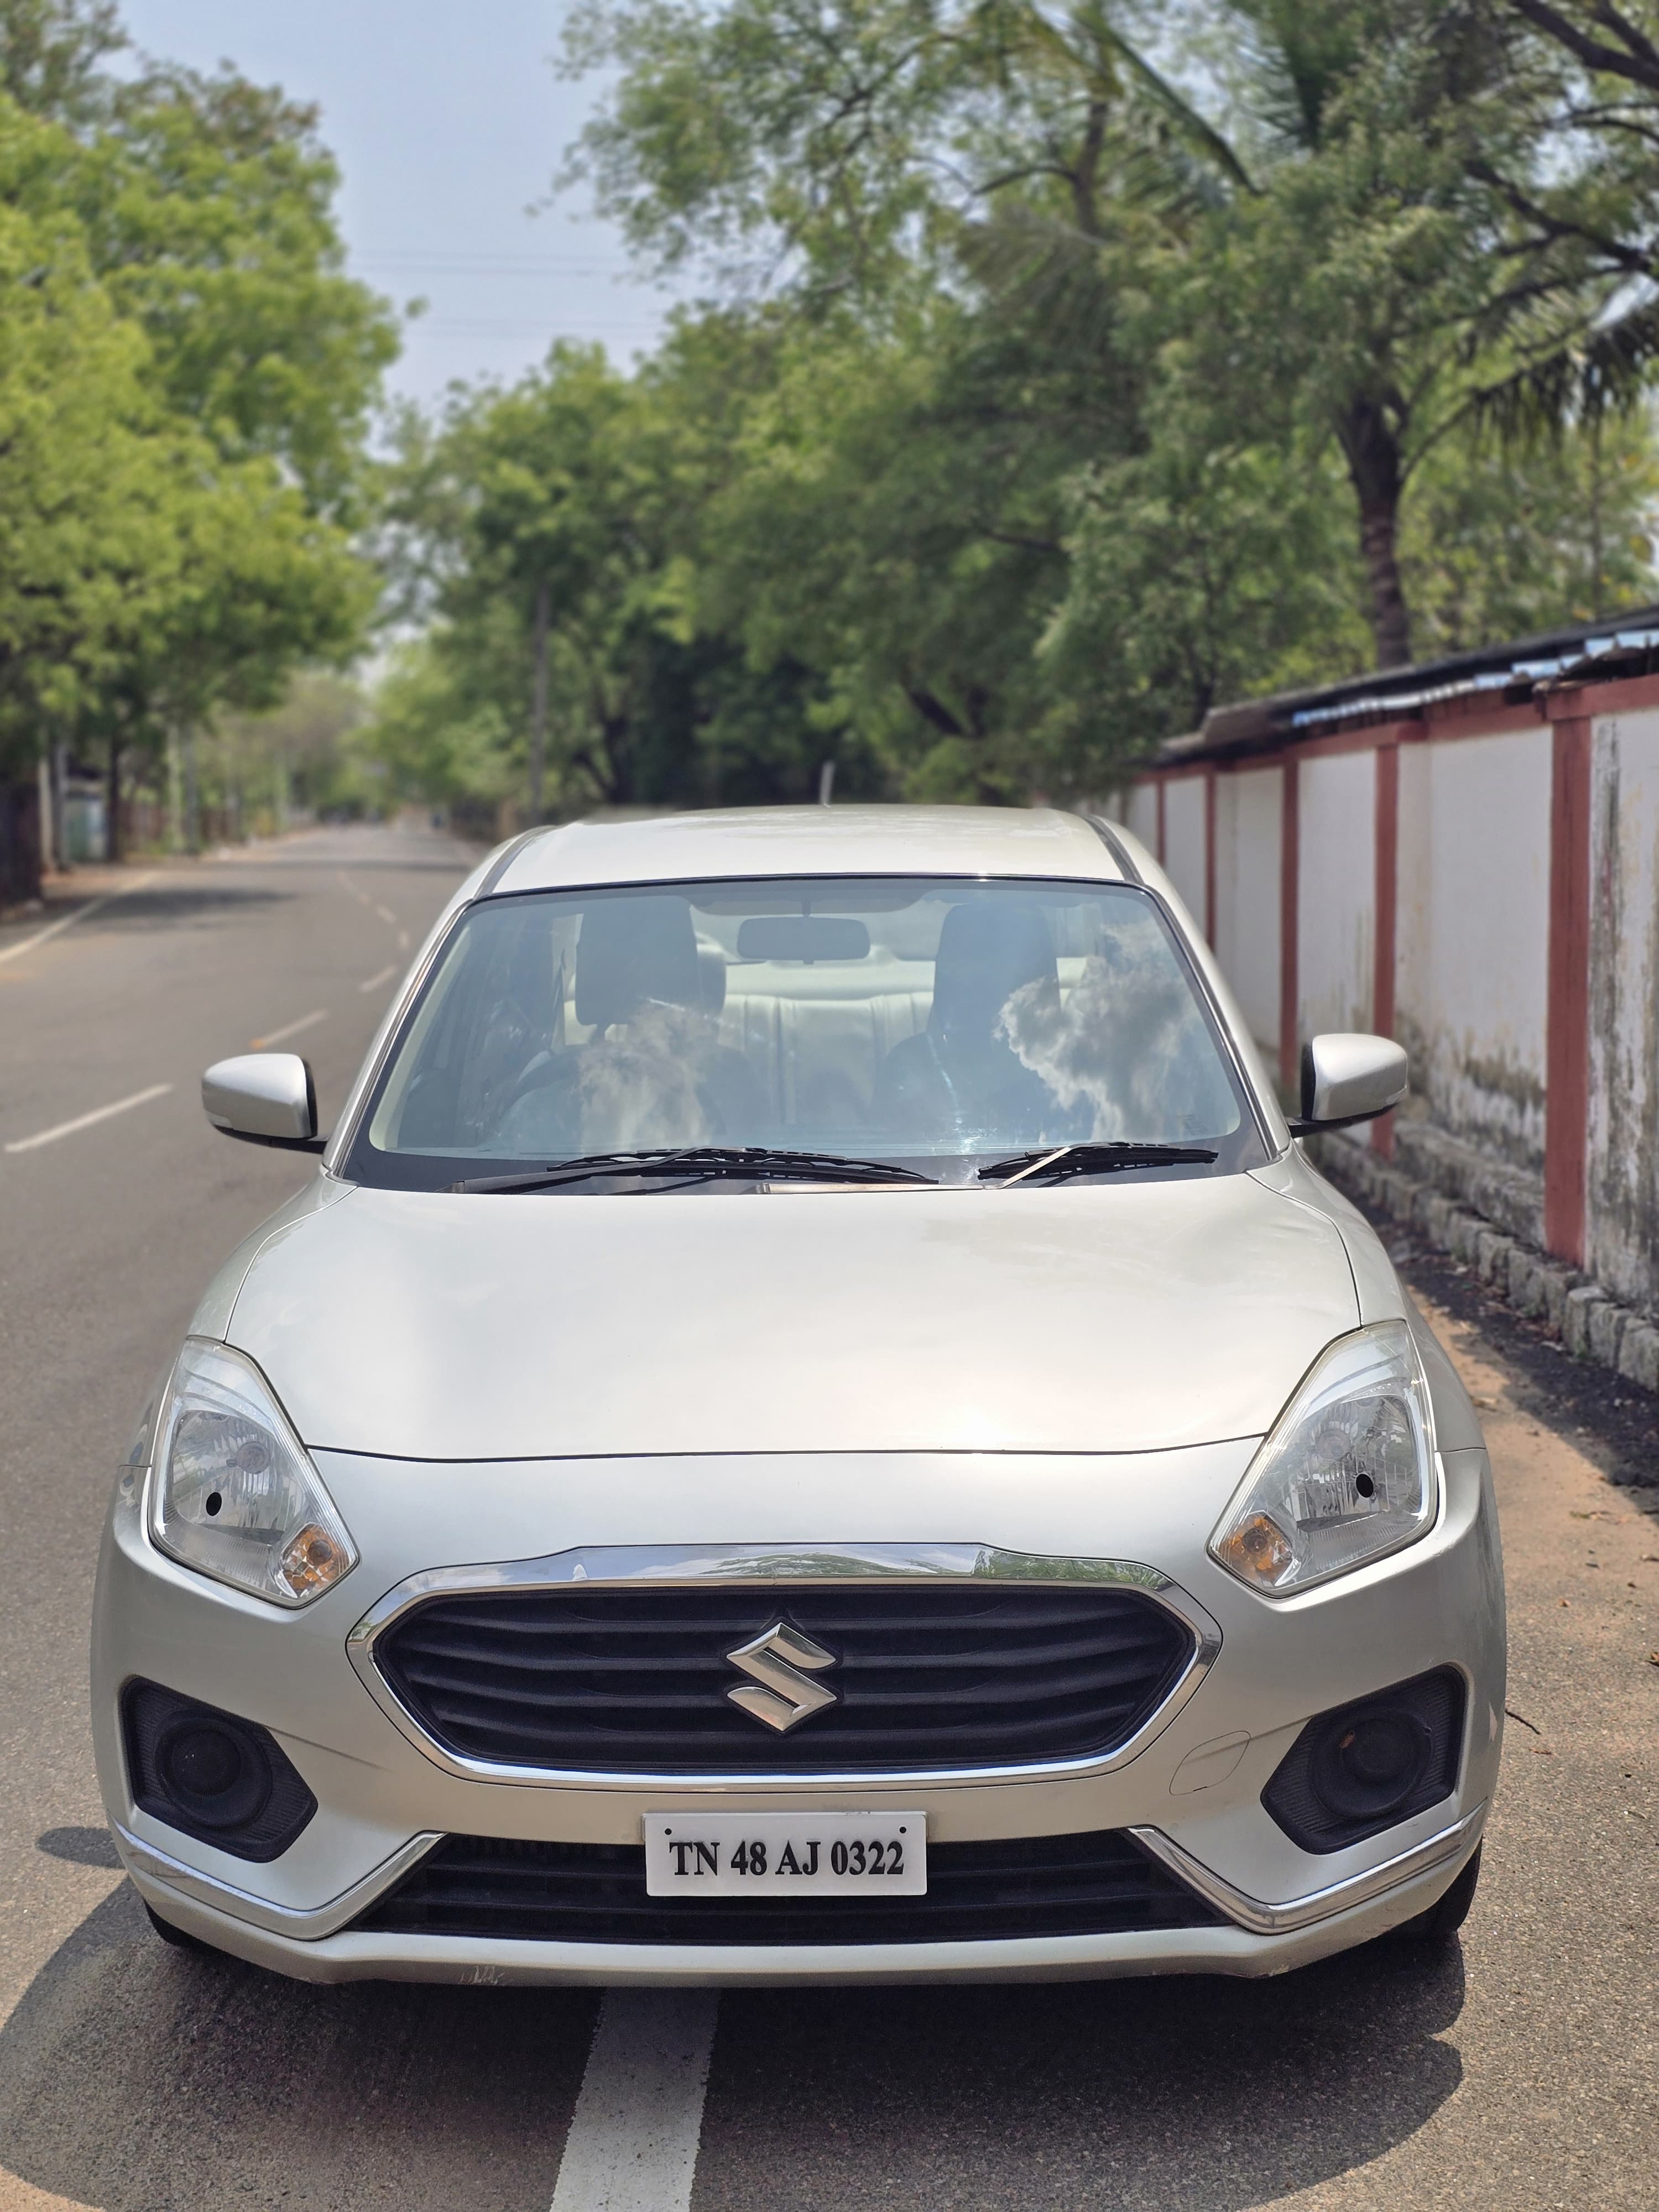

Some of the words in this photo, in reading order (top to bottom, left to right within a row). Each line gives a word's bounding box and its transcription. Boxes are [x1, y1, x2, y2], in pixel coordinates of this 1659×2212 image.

[669, 1841, 720, 1876] TN
[731, 1840, 768, 1876] 48
[775, 1840, 821, 1876] AJ
[831, 1840, 904, 1876] 0322
